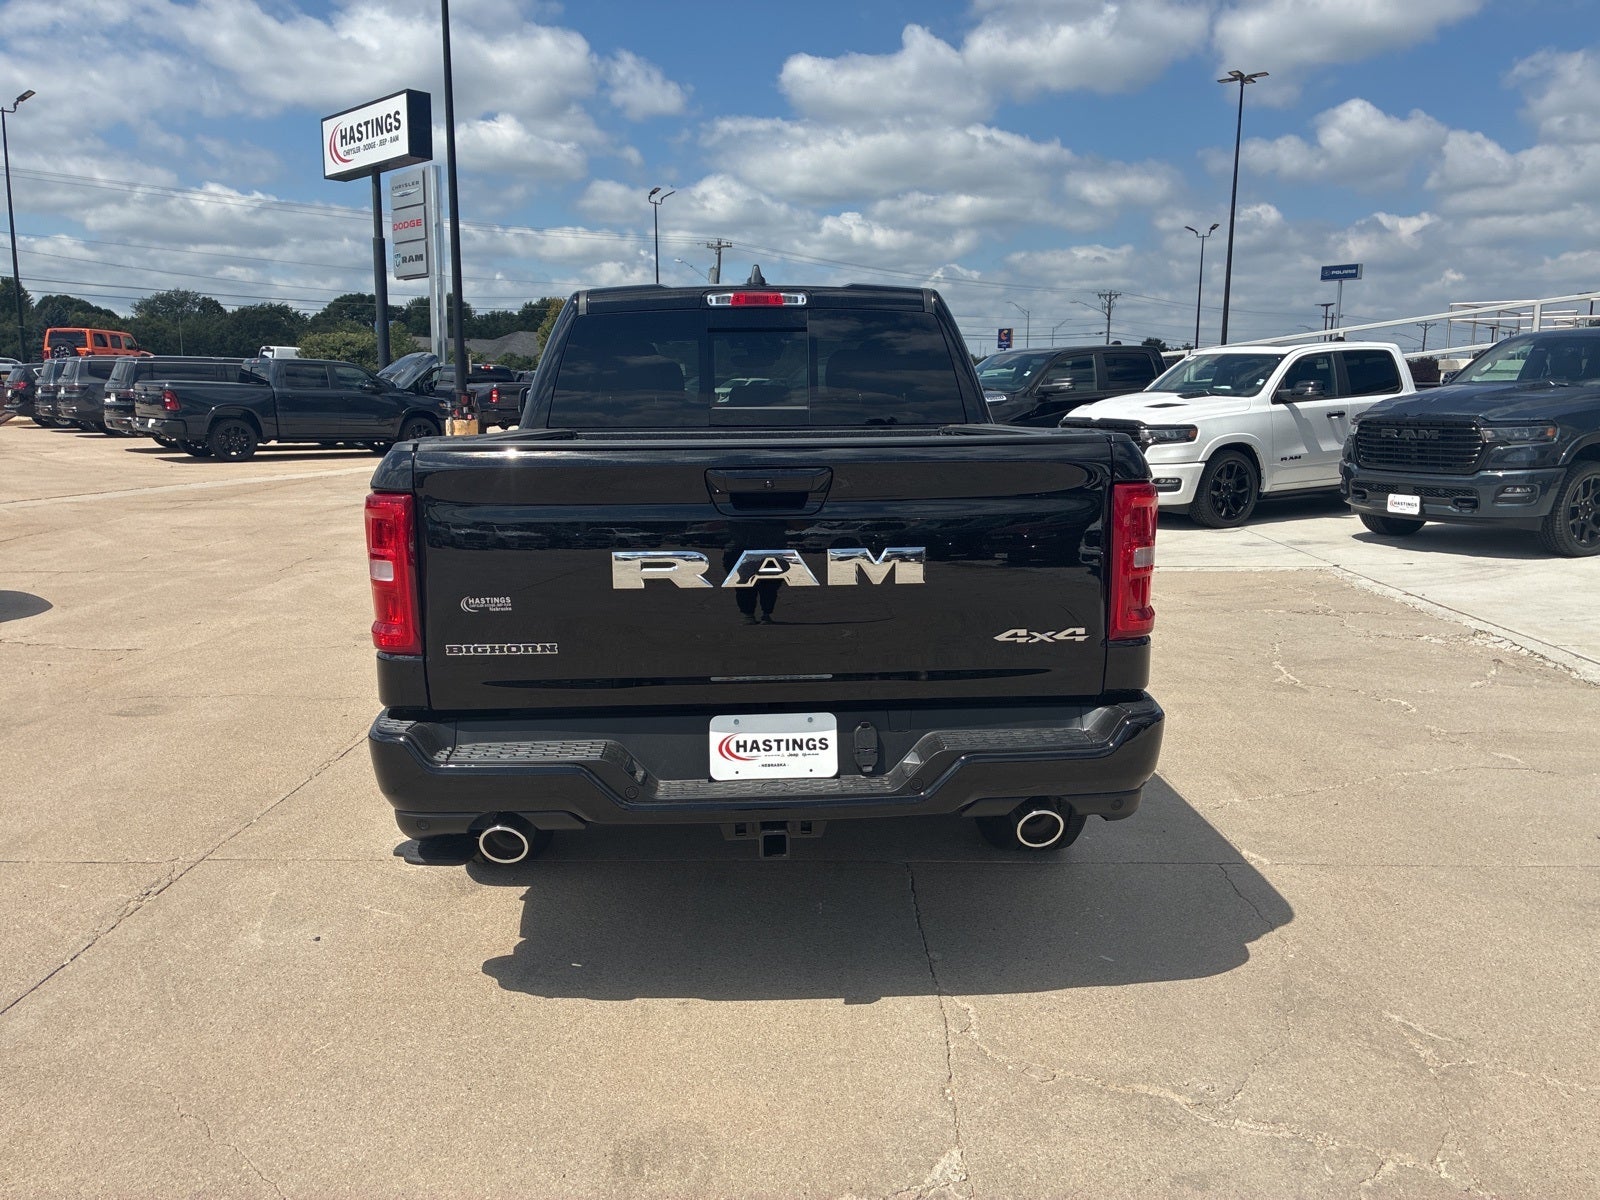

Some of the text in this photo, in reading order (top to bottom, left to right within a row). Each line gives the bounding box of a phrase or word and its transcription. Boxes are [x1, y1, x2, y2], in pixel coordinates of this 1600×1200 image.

[339, 110, 401, 148] HASTINGS
[343, 134, 399, 157] CHRYSLER DODGE JEEP RAM
[392, 180, 420, 191] CHRYSLER
[393, 218, 422, 231] DODGE
[401, 253, 424, 264] RAM
[1380, 428, 1439, 440] RAM
[611, 546, 927, 590] RAM
[993, 627, 1090, 643] 4x4
[446, 643, 558, 655] BIGHORN
[735, 737, 829, 753] HASTINGS
